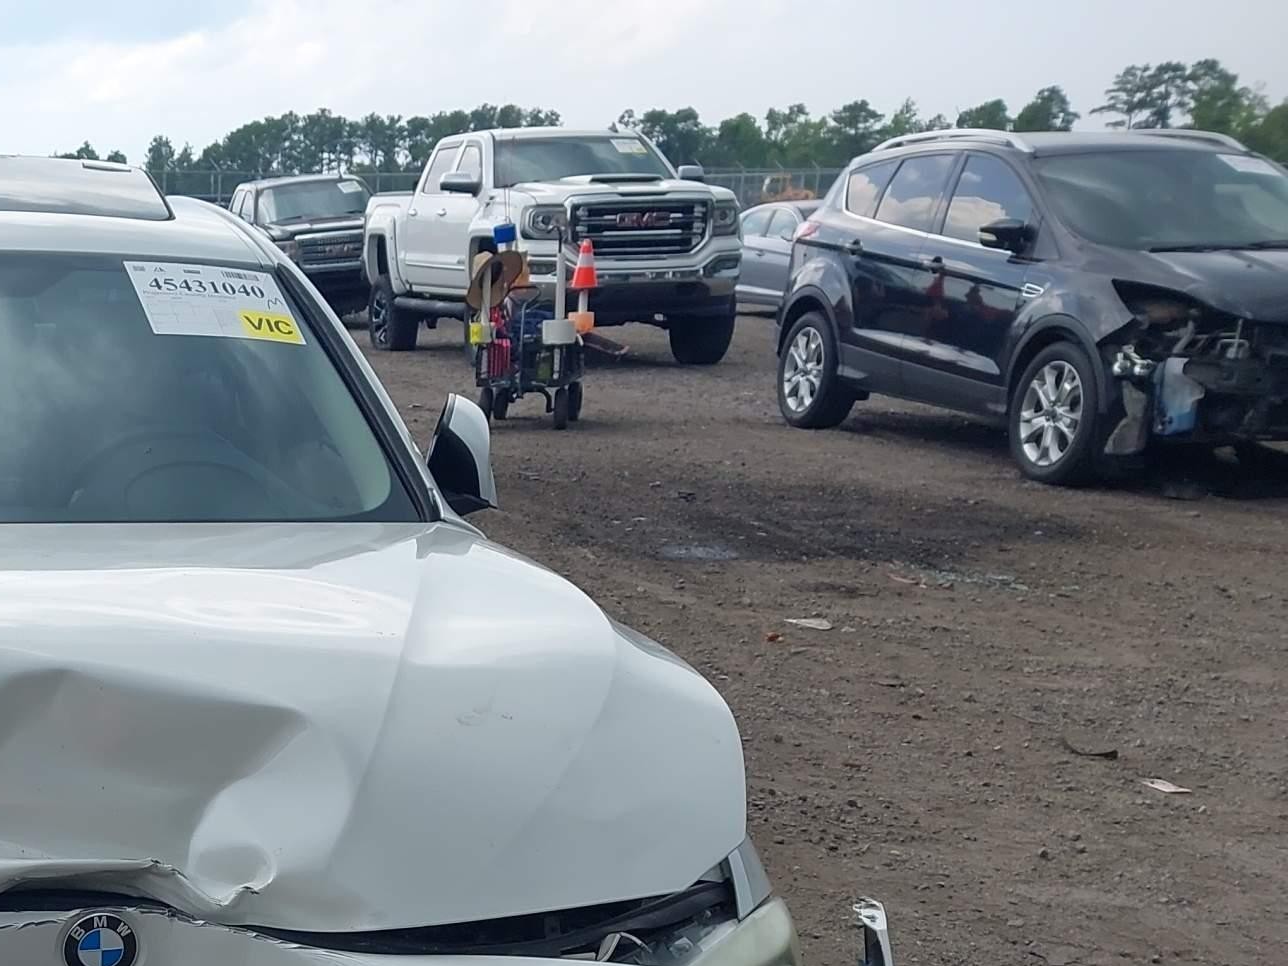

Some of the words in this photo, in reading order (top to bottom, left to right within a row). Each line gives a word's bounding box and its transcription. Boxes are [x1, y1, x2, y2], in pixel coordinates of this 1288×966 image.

[149, 277, 265, 299] 45431040
[244, 315, 294, 336] VIC
[70, 916, 132, 941] BMW
